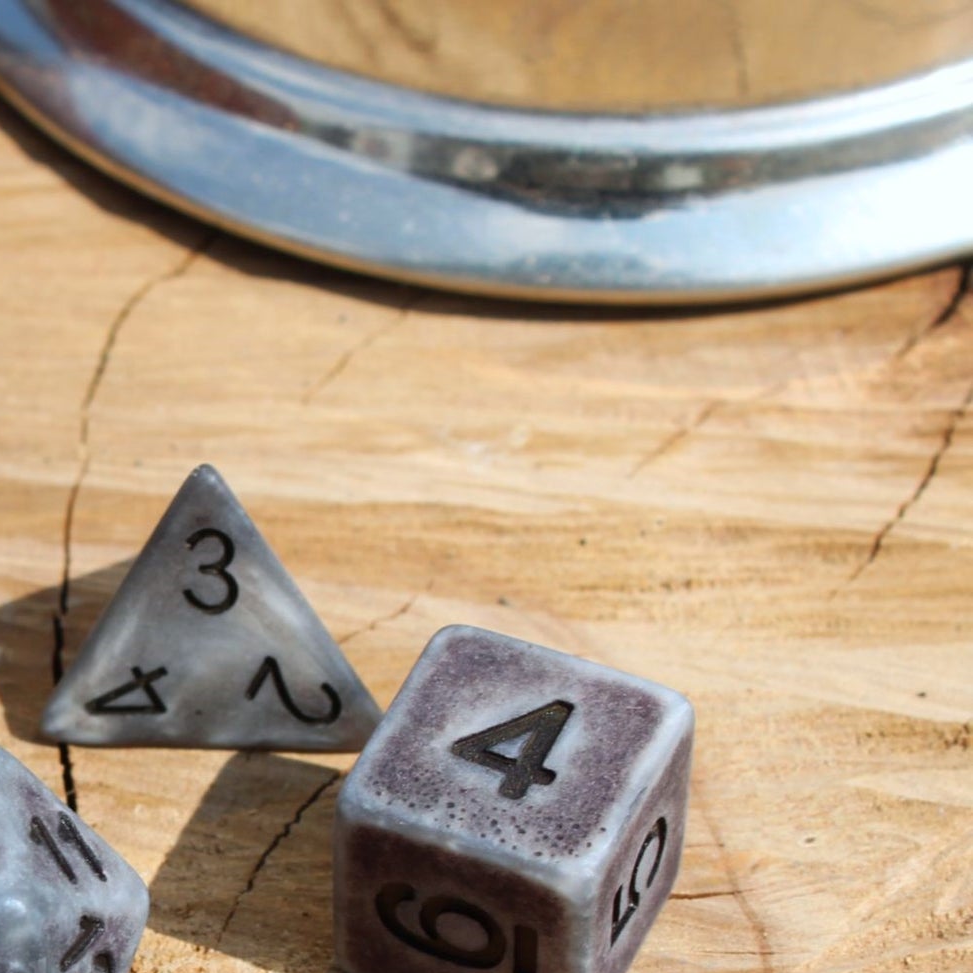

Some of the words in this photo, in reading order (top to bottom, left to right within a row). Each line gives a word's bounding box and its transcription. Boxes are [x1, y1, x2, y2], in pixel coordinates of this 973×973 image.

[183, 528, 239, 615] 3
[84, 666, 168, 715] 4
[245, 656, 342, 726] 2
[450, 699, 575, 800] 4
[30, 810, 107, 885] 11
[611, 816, 667, 948] 5
